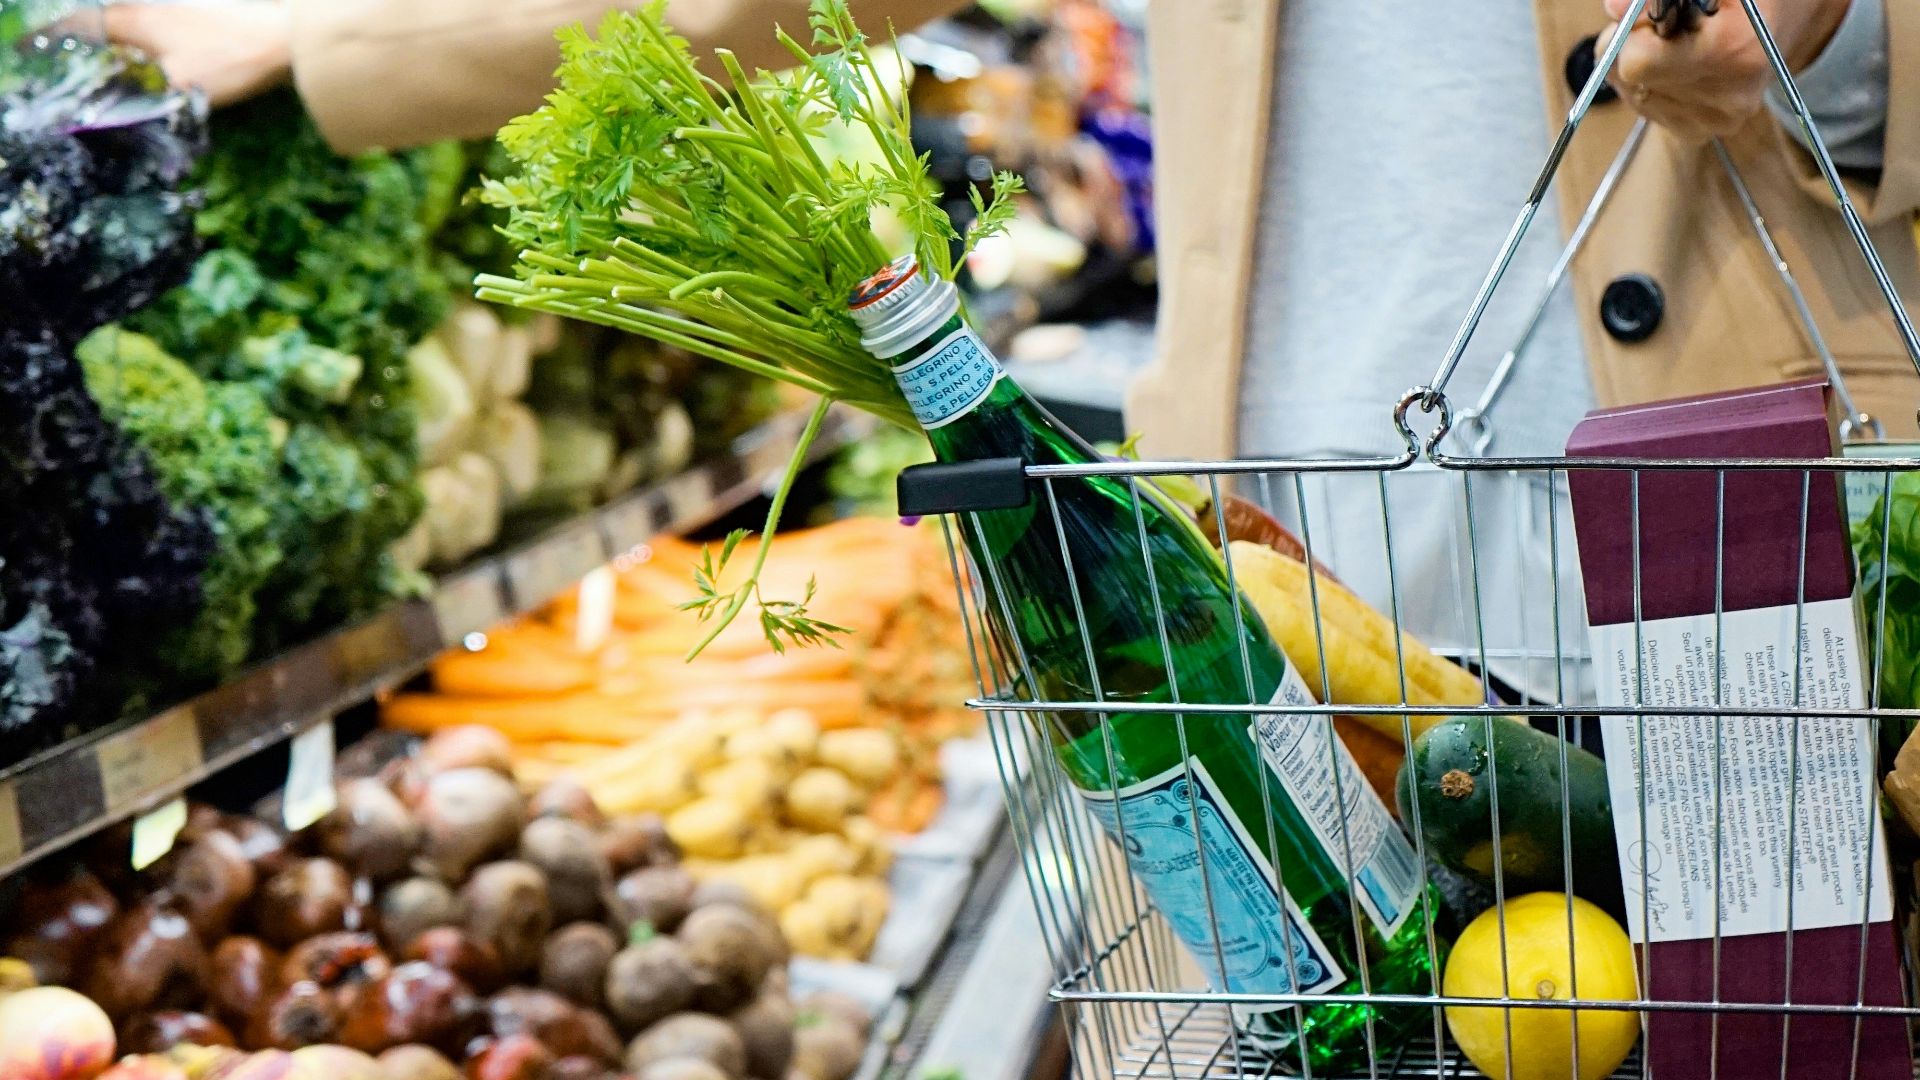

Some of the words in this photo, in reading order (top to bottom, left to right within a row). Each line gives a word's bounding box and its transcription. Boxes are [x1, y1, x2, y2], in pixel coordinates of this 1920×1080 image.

[1682, 631, 1693, 653] Seul
[1705, 635, 1714, 648] de
[1823, 627, 1836, 669] delicious
[1835, 635, 1844, 646] At
[1617, 649, 1626, 671] vous
[1648, 639, 1662, 682] Délicieux
[1686, 655, 1693, 667] un
[1695, 646, 1703, 668] avec
[1756, 651, 1764, 666] but
[1766, 644, 1777, 670] these
[1805, 655, 1812, 663] &
[1833, 648, 1849, 680] Lesley
[1621, 673, 1628, 685] ne
[1744, 652, 1756, 686] cheese
[1806, 666, 1815, 681] her
[1655, 684, 1662, 697] au
[1675, 664, 1689, 707] supérieu
[1685, 669, 1699, 702] produit
[1697, 669, 1708, 692] soin,
[1756, 668, 1768, 694] really
[1769, 673, 1781, 705] unique
[1819, 678, 1827, 694] are
[1722, 682, 1733, 706] Stow
[1738, 686, 1748, 708] snac
[1750, 688, 1757, 697] or
[1782, 680, 1793, 710] CRIS
[1809, 684, 1818, 708] team
[1664, 678, 1679, 730] CRAEZ
[1831, 697, 1844, 725] The
[1649, 724, 1657, 736] de
[1682, 716, 1694, 749] pouvait
[1705, 715, 1714, 740] etites
[1750, 700, 1764, 743] apasto.
[1773, 706, 1786, 746] ackers
[1813, 716, 1821, 733] ink
[1267, 725, 1292, 752] Valeur
[1626, 725, 1637, 746] plus
[1662, 736, 1670, 752] ces
[1765, 724, 1775, 748] when
[1802, 724, 1814, 758] scratch
[1816, 736, 1824, 751] the
[1825, 726, 1833, 744] with
[1671, 731, 1684, 762] POUR
[1729, 737, 1741, 766] Foods
[1747, 749, 1755, 764] are
[1758, 747, 1767, 762] We
[1779, 749, 1787, 765] are
[1827, 747, 1835, 765] care
[1835, 728, 1848, 767] fabulous
[1848, 737, 1860, 766] Foods
[1631, 747, 1640, 769] vous
[1694, 740, 1709, 779] fabriqué
[1768, 751, 1779, 783] topped
[1816, 753, 1826, 773] only
[1662, 754, 1676, 802] craquelins
[1676, 763, 1687, 786] CES
[1687, 752, 1700, 793] satisfaire
[1721, 757, 1734, 796] fabuleux
[1733, 768, 1744, 795] adore
[1749, 766, 1758, 787] sure
[1760, 764, 1768, 781] are
[1805, 759, 1817, 785] using
[1841, 769, 1852, 797] crisps
[1853, 769, 1860, 782] we
[1658, 787, 1665, 799] de
[1702, 780, 1711, 802] avec
[1773, 785, 1782, 804] with
[1811, 787, 1819, 802] our
[1819, 775, 1828, 792] way
[1832, 781, 1842, 807] small
[1855, 785, 1865, 804] love
[1680, 788, 1690, 812] FINS
[1751, 790, 1759, 807] you
[1762, 782, 1775, 822] addicted
[1823, 795, 1830, 805] to
[1846, 799, 1855, 820] from
[1657, 802, 1672, 840] fromage
[1671, 804, 1679, 824] sont
[1692, 796, 1702, 825] Lesley
[1706, 804, 1715, 821] des
[1736, 798, 1751, 839] fabriquer
[1776, 806, 1785, 826] your
[1813, 805, 1824, 830] finest
[1825, 807, 1834, 833] make
[1698, 828, 1705, 837] et
[1726, 798, 1740, 846] craquelins
[1757, 825, 1765, 838] be
[1768, 825, 1776, 834] to
[1665, 842, 1672, 854] ou
[1682, 814, 1701, 882] CRAQUELINS
[1743, 840, 1752, 850] et
[1770, 836, 1779, 852] this
[1847, 823, 1860, 860] Lesley's
[1724, 860, 1732, 872] de
[1733, 848, 1742, 868] sont
[1745, 852, 1754, 875] vous
[1827, 844, 1839, 868] great
[1769, 854, 1782, 889] yummy
[1796, 872, 1804, 892] own
[1853, 863, 1865, 896] kitchen
[1748, 876, 1758, 898] offrir
[1831, 870, 1844, 905] product
